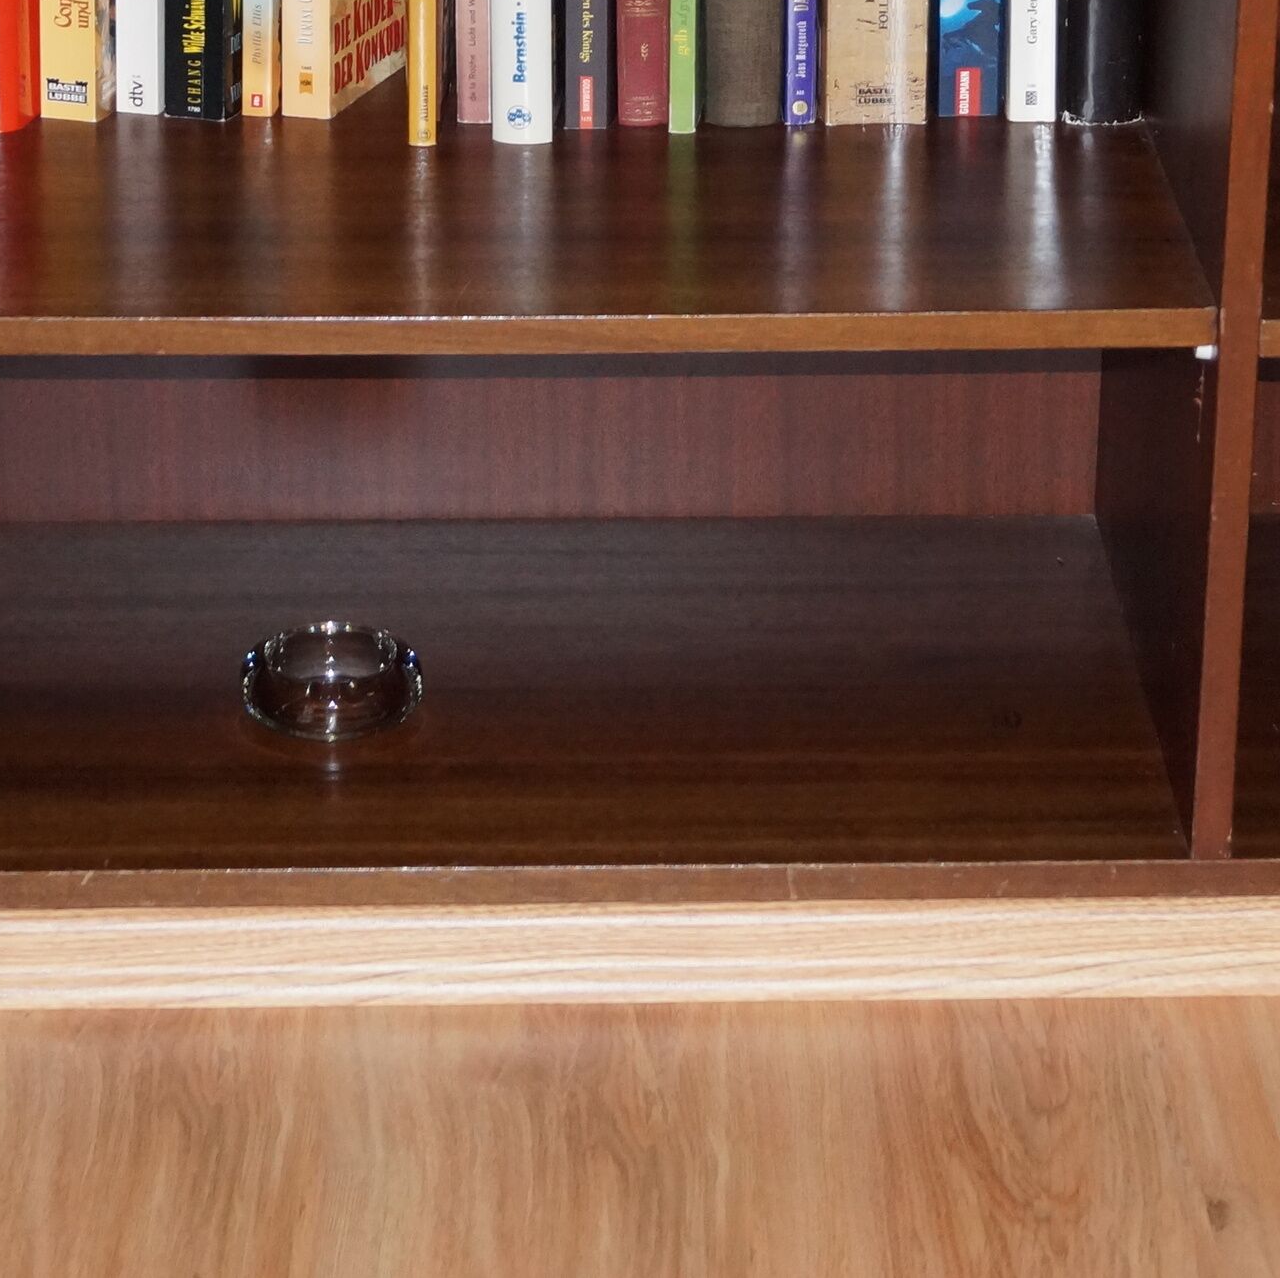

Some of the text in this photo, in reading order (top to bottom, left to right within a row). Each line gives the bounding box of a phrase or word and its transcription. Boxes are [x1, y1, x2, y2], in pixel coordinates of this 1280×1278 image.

[74, 0, 91, 29] und
[252, 3, 263, 27] Ellis
[582, 11, 594, 28] des
[1027, 17, 1039, 45] Gary
[252, 29, 264, 65] Phyllis
[335, 19, 352, 56] DIE
[512, 11, 527, 83] Bernstein
[581, 30, 595, 63] Königs
[48, 82, 86, 93] BASTEI
[187, 58, 202, 104] CHANG
[334, 57, 353, 95] DER
[960, 70, 970, 115] GOLDMANN
[130, 81, 142, 107] dtv
